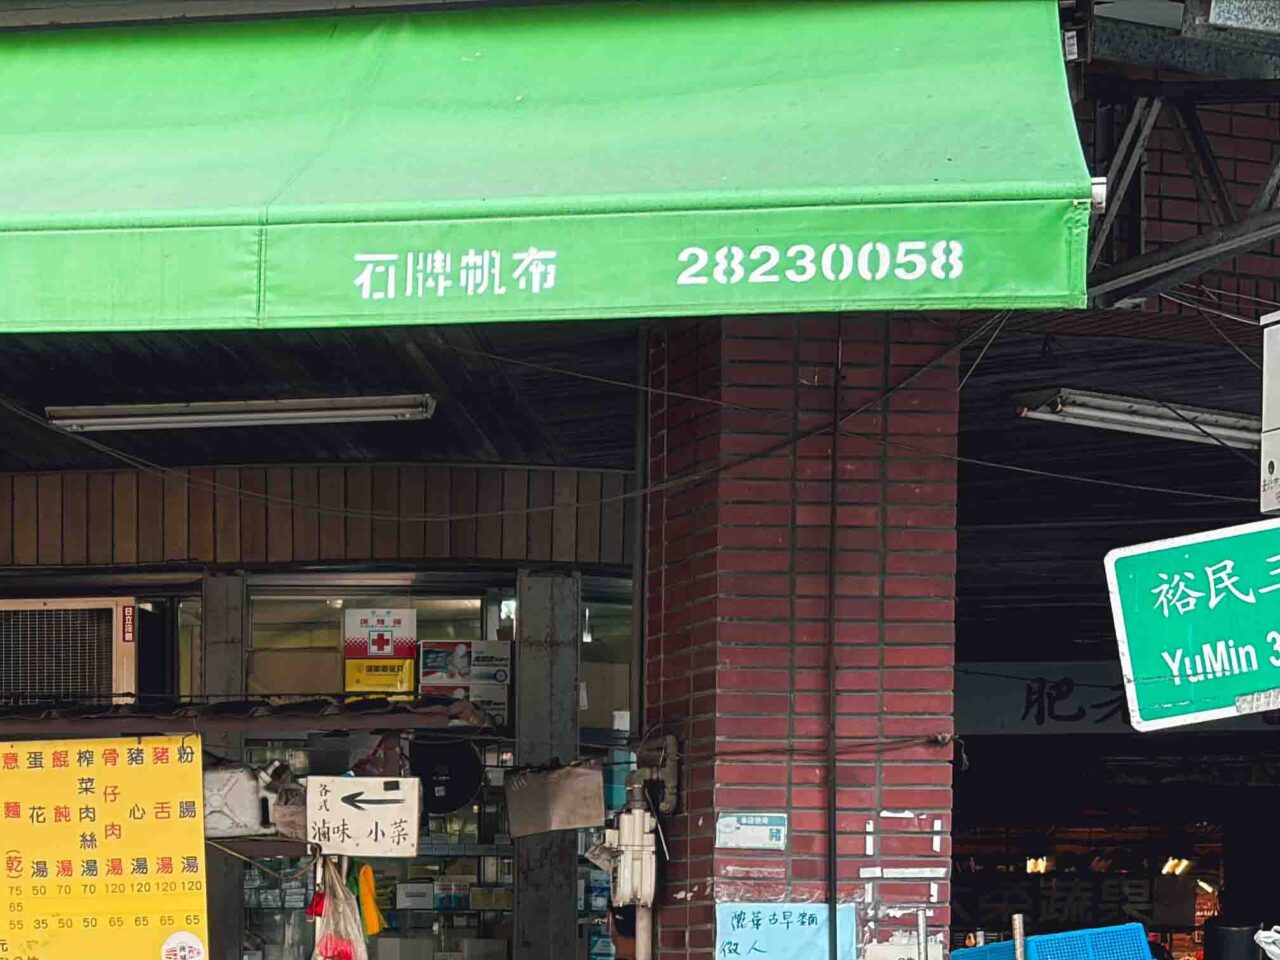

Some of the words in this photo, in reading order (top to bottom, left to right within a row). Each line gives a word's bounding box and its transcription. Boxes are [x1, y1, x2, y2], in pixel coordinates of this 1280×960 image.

[353, 247, 557, 299] 石牌帆布
[677, 240, 963, 285] 28230058
[1161, 639, 1258, 686] YuMin
[26, 751, 48, 878] 蛋花湯
[52, 750, 73, 878] 餛飩湯
[76, 749, 98, 877] 榨菜肉絲湯
[101, 748, 123, 876] 骨仔肉湯
[127, 747, 148, 875] 豬心湯
[152, 746, 173, 874] 豬舌湯
[177, 746, 198, 874] 粉腸湯
[319, 783, 331, 812] 各式
[8, 886, 22, 896] 75
[32, 885, 46, 895] 50
[56, 885, 71, 895] 70
[82, 884, 96, 894] 70
[105, 883, 125, 893] 120
[131, 883, 151, 892] 120
[156, 882, 176, 892] 120
[181, 881, 202, 891] 120
[9, 902, 23, 912] 65
[9, 920, 23, 930] 55
[33, 919, 48, 930] 35
[58, 918, 72, 928] 50
[83, 917, 97, 928] 50
[109, 917, 123, 927] 65
[134, 916, 149, 926] 65
[159, 915, 174, 926] 65
[185, 915, 200, 925] 65
